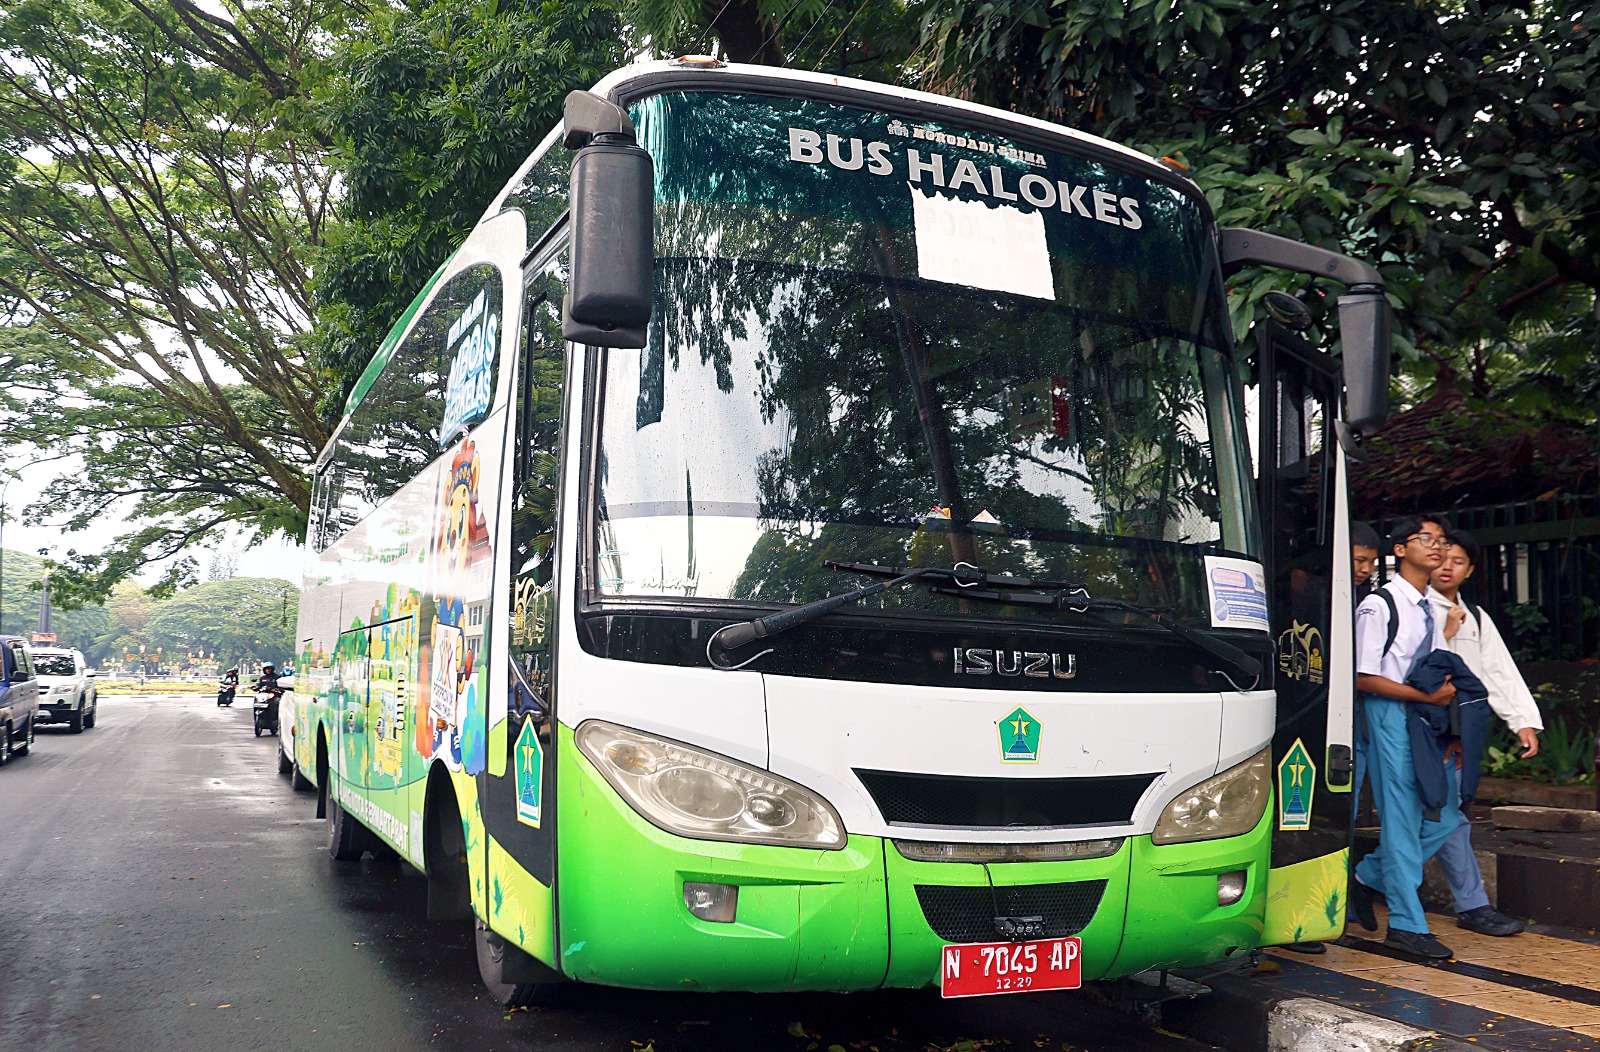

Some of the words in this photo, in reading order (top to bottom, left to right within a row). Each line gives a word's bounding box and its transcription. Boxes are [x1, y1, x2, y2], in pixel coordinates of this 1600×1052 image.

[912, 127, 995, 154] MORODADI
[998, 145, 1047, 166] PRIMA
[788, 127, 894, 176] BUS
[907, 148, 1143, 230] HALOKES
[953, 647, 1077, 679] ISUZU
[946, 949, 960, 979] N
[980, 944, 1038, 977] 7045
[1050, 941, 1079, 971] AP
